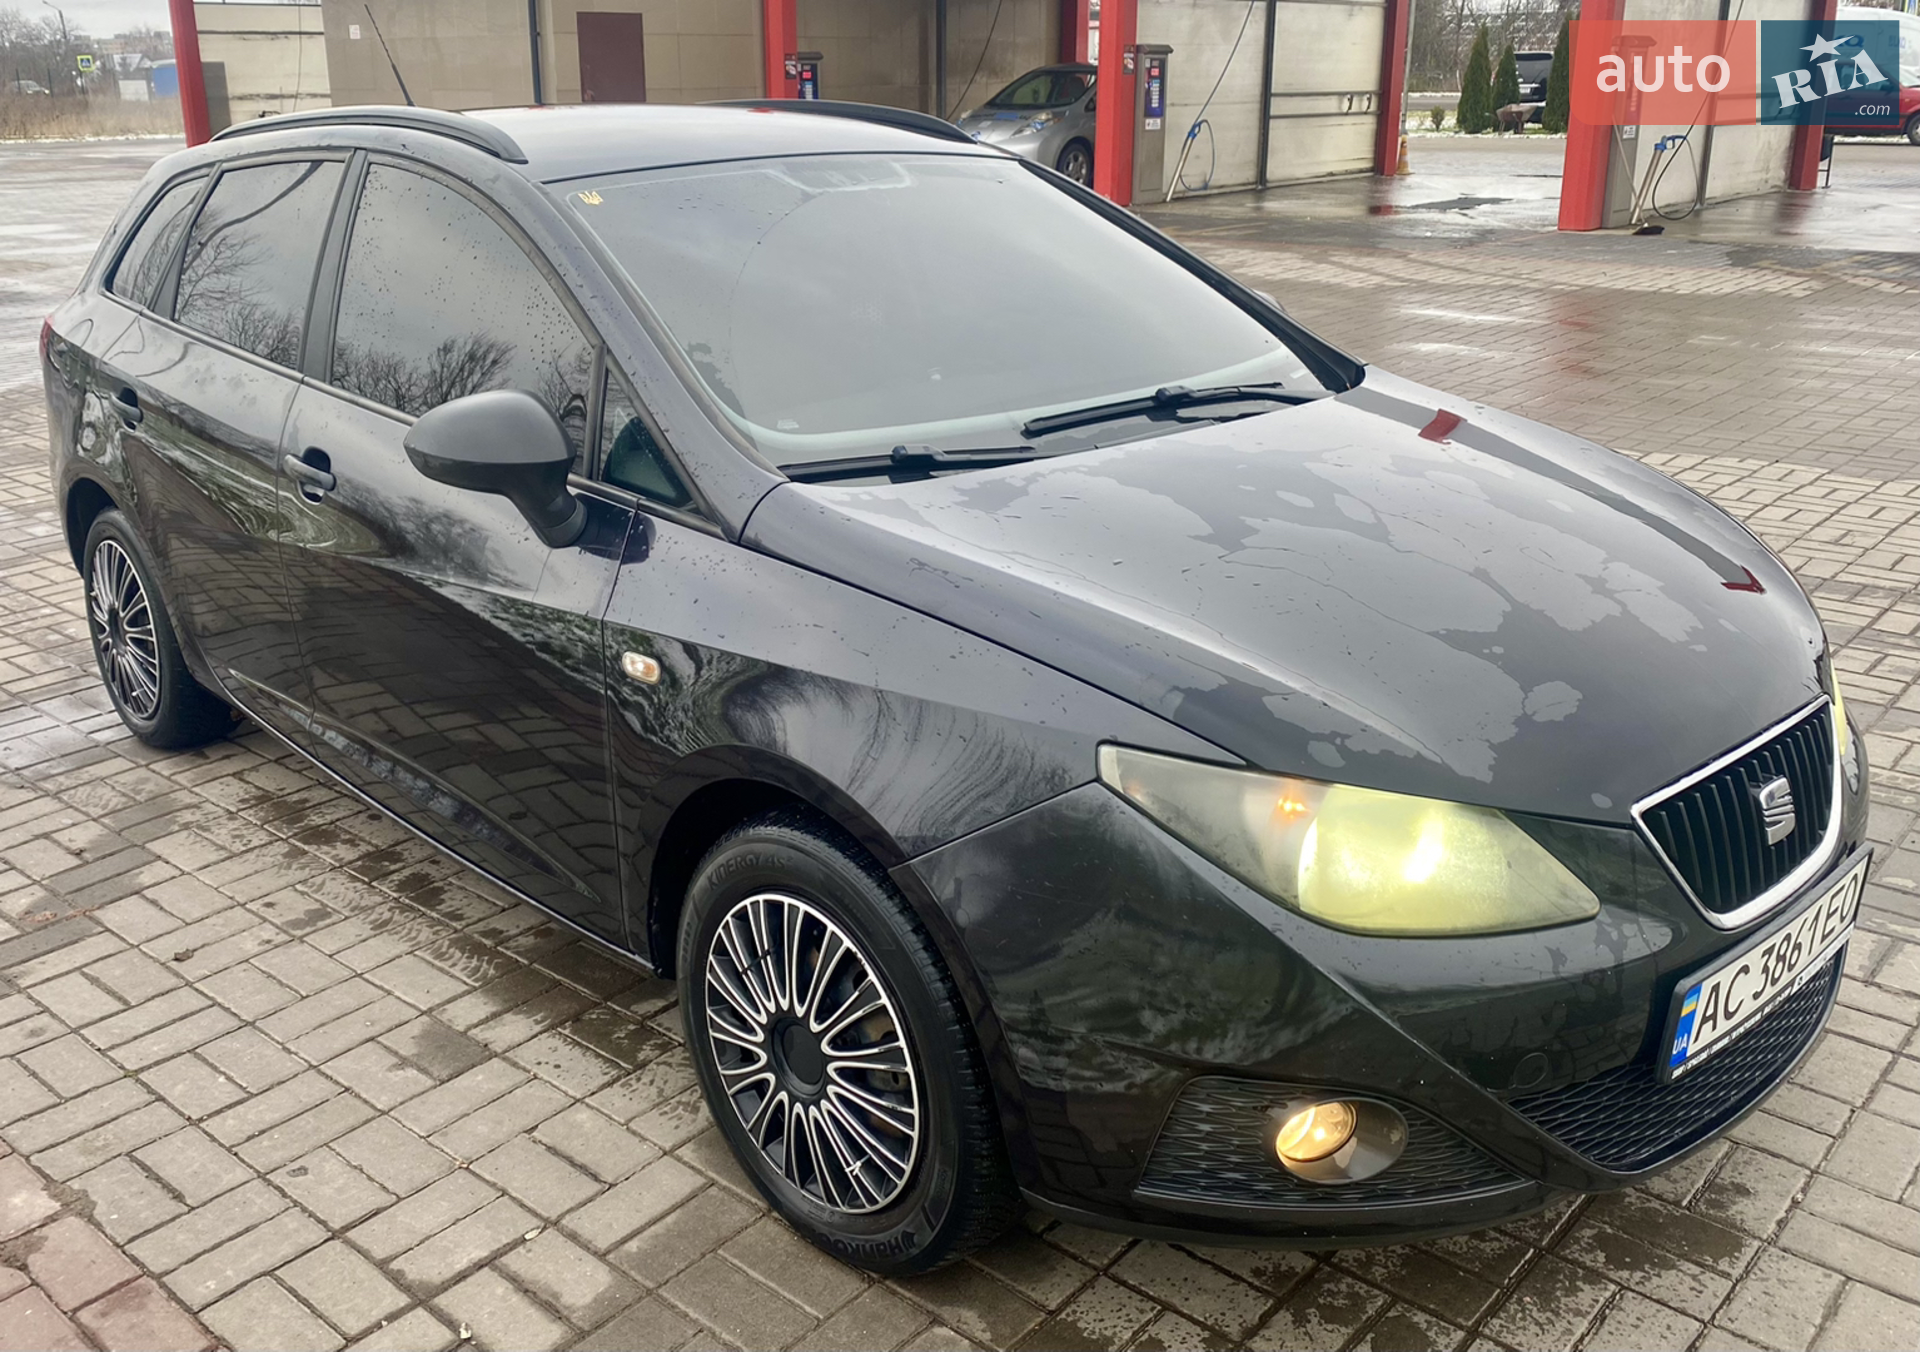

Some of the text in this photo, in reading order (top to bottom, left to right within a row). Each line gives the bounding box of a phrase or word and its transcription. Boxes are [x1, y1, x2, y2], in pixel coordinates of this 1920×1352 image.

[1693, 963, 1751, 1045] AC
[1752, 904, 1824, 1001] 3861
[1672, 1033, 1688, 1055] UA
